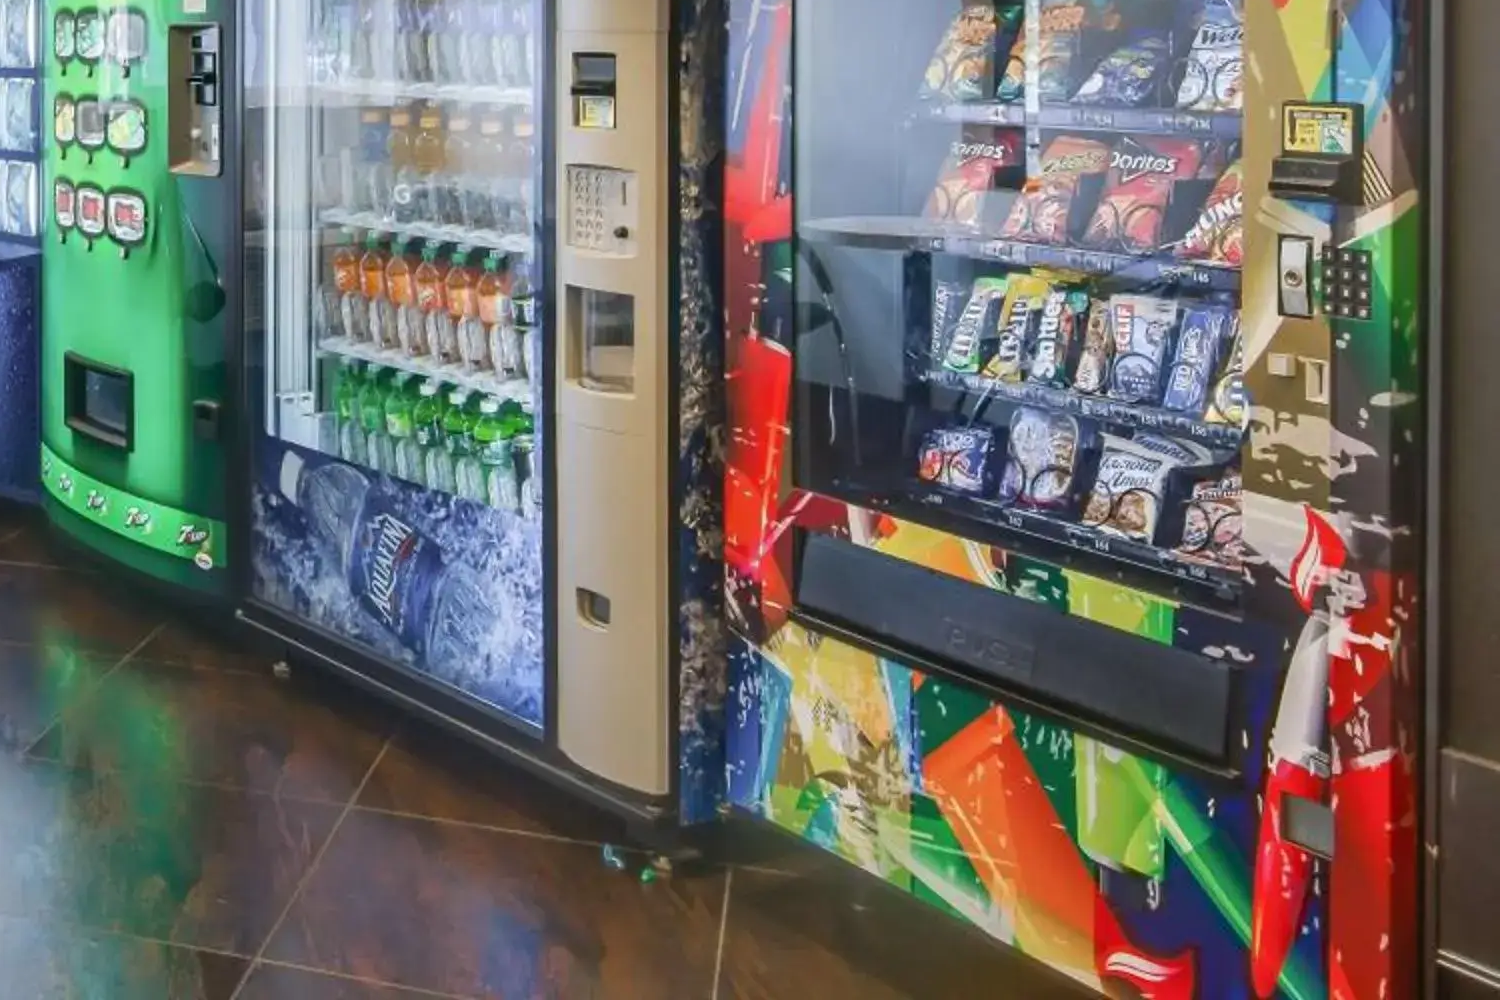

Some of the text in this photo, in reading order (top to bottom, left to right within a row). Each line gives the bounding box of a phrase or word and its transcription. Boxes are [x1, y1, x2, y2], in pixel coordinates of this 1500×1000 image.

[1110, 151, 1179, 173] Doritos
[393, 183, 411, 205] G
[176, 523, 208, 546] 7UP
[368, 514, 413, 626] AQUAFINA
